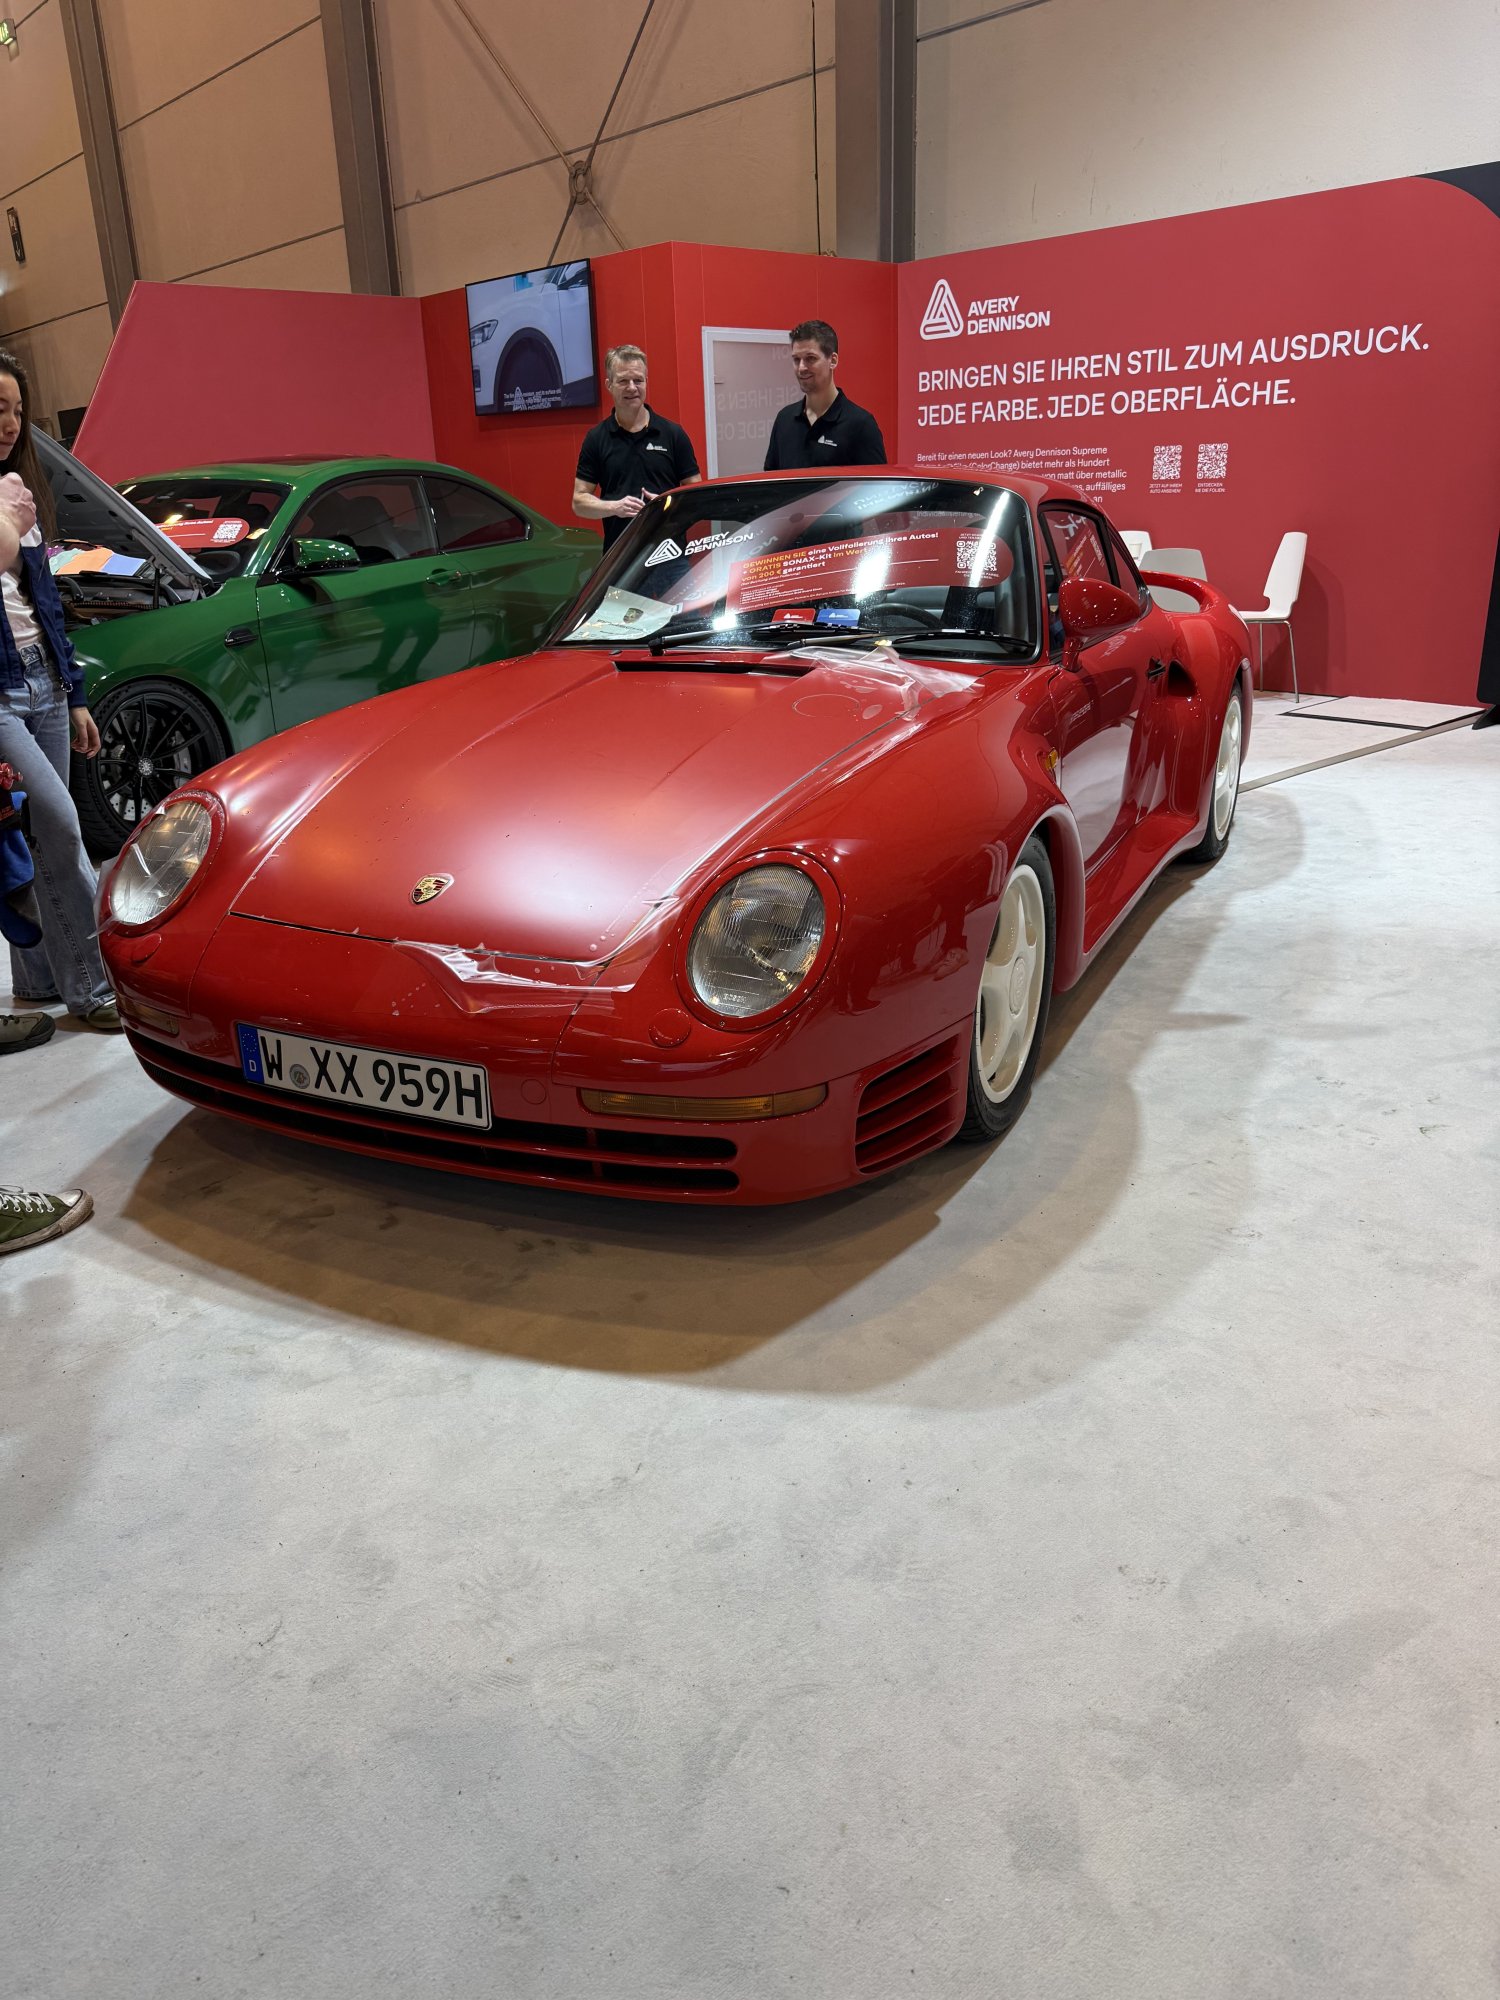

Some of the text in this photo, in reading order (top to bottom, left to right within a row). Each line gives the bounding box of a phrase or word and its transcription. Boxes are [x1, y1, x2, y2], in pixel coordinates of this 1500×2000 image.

[967, 295, 1020, 317] AVERY
[967, 310, 1051, 336] DENNISON
[918, 323, 1430, 392] BRINGEN SIE IHREN STIL ZUM AUSDRUCK.
[917, 377, 1296, 427] JEDE FARBE. JEDE OBERFLÄCHE.
[917, 446, 1108, 462] Bereit für einen neuen Look? Avery Dennison Supreme
[1021, 460, 1043, 469] bietet
[1044, 460, 1063, 468] mehr
[1064, 459, 1076, 467] als
[1077, 458, 1110, 467] Hundert
[1057, 471, 1074, 480] matt
[1075, 470, 1094, 479] über
[1095, 469, 1127, 479] metallic
[1085, 482, 1126, 492] auffälliges
[684, 532, 754, 556] DENNISON
[685, 531, 730, 549] AVERY
[743, 554, 791, 569] GEWINNEN
[792, 550, 807, 559] SIE
[807, 548, 827, 556] eine
[828, 537, 884, 552] Vollfolierung
[909, 532, 939, 540] Autos!
[749, 563, 782, 574] GRATIS
[782, 553, 832, 567] SONAX-Kit
[758, 571, 775, 579] 200
[782, 561, 826, 574] garantiert
[249, 1059, 257, 1072] D
[260, 1035, 483, 1119] W XX 959H
